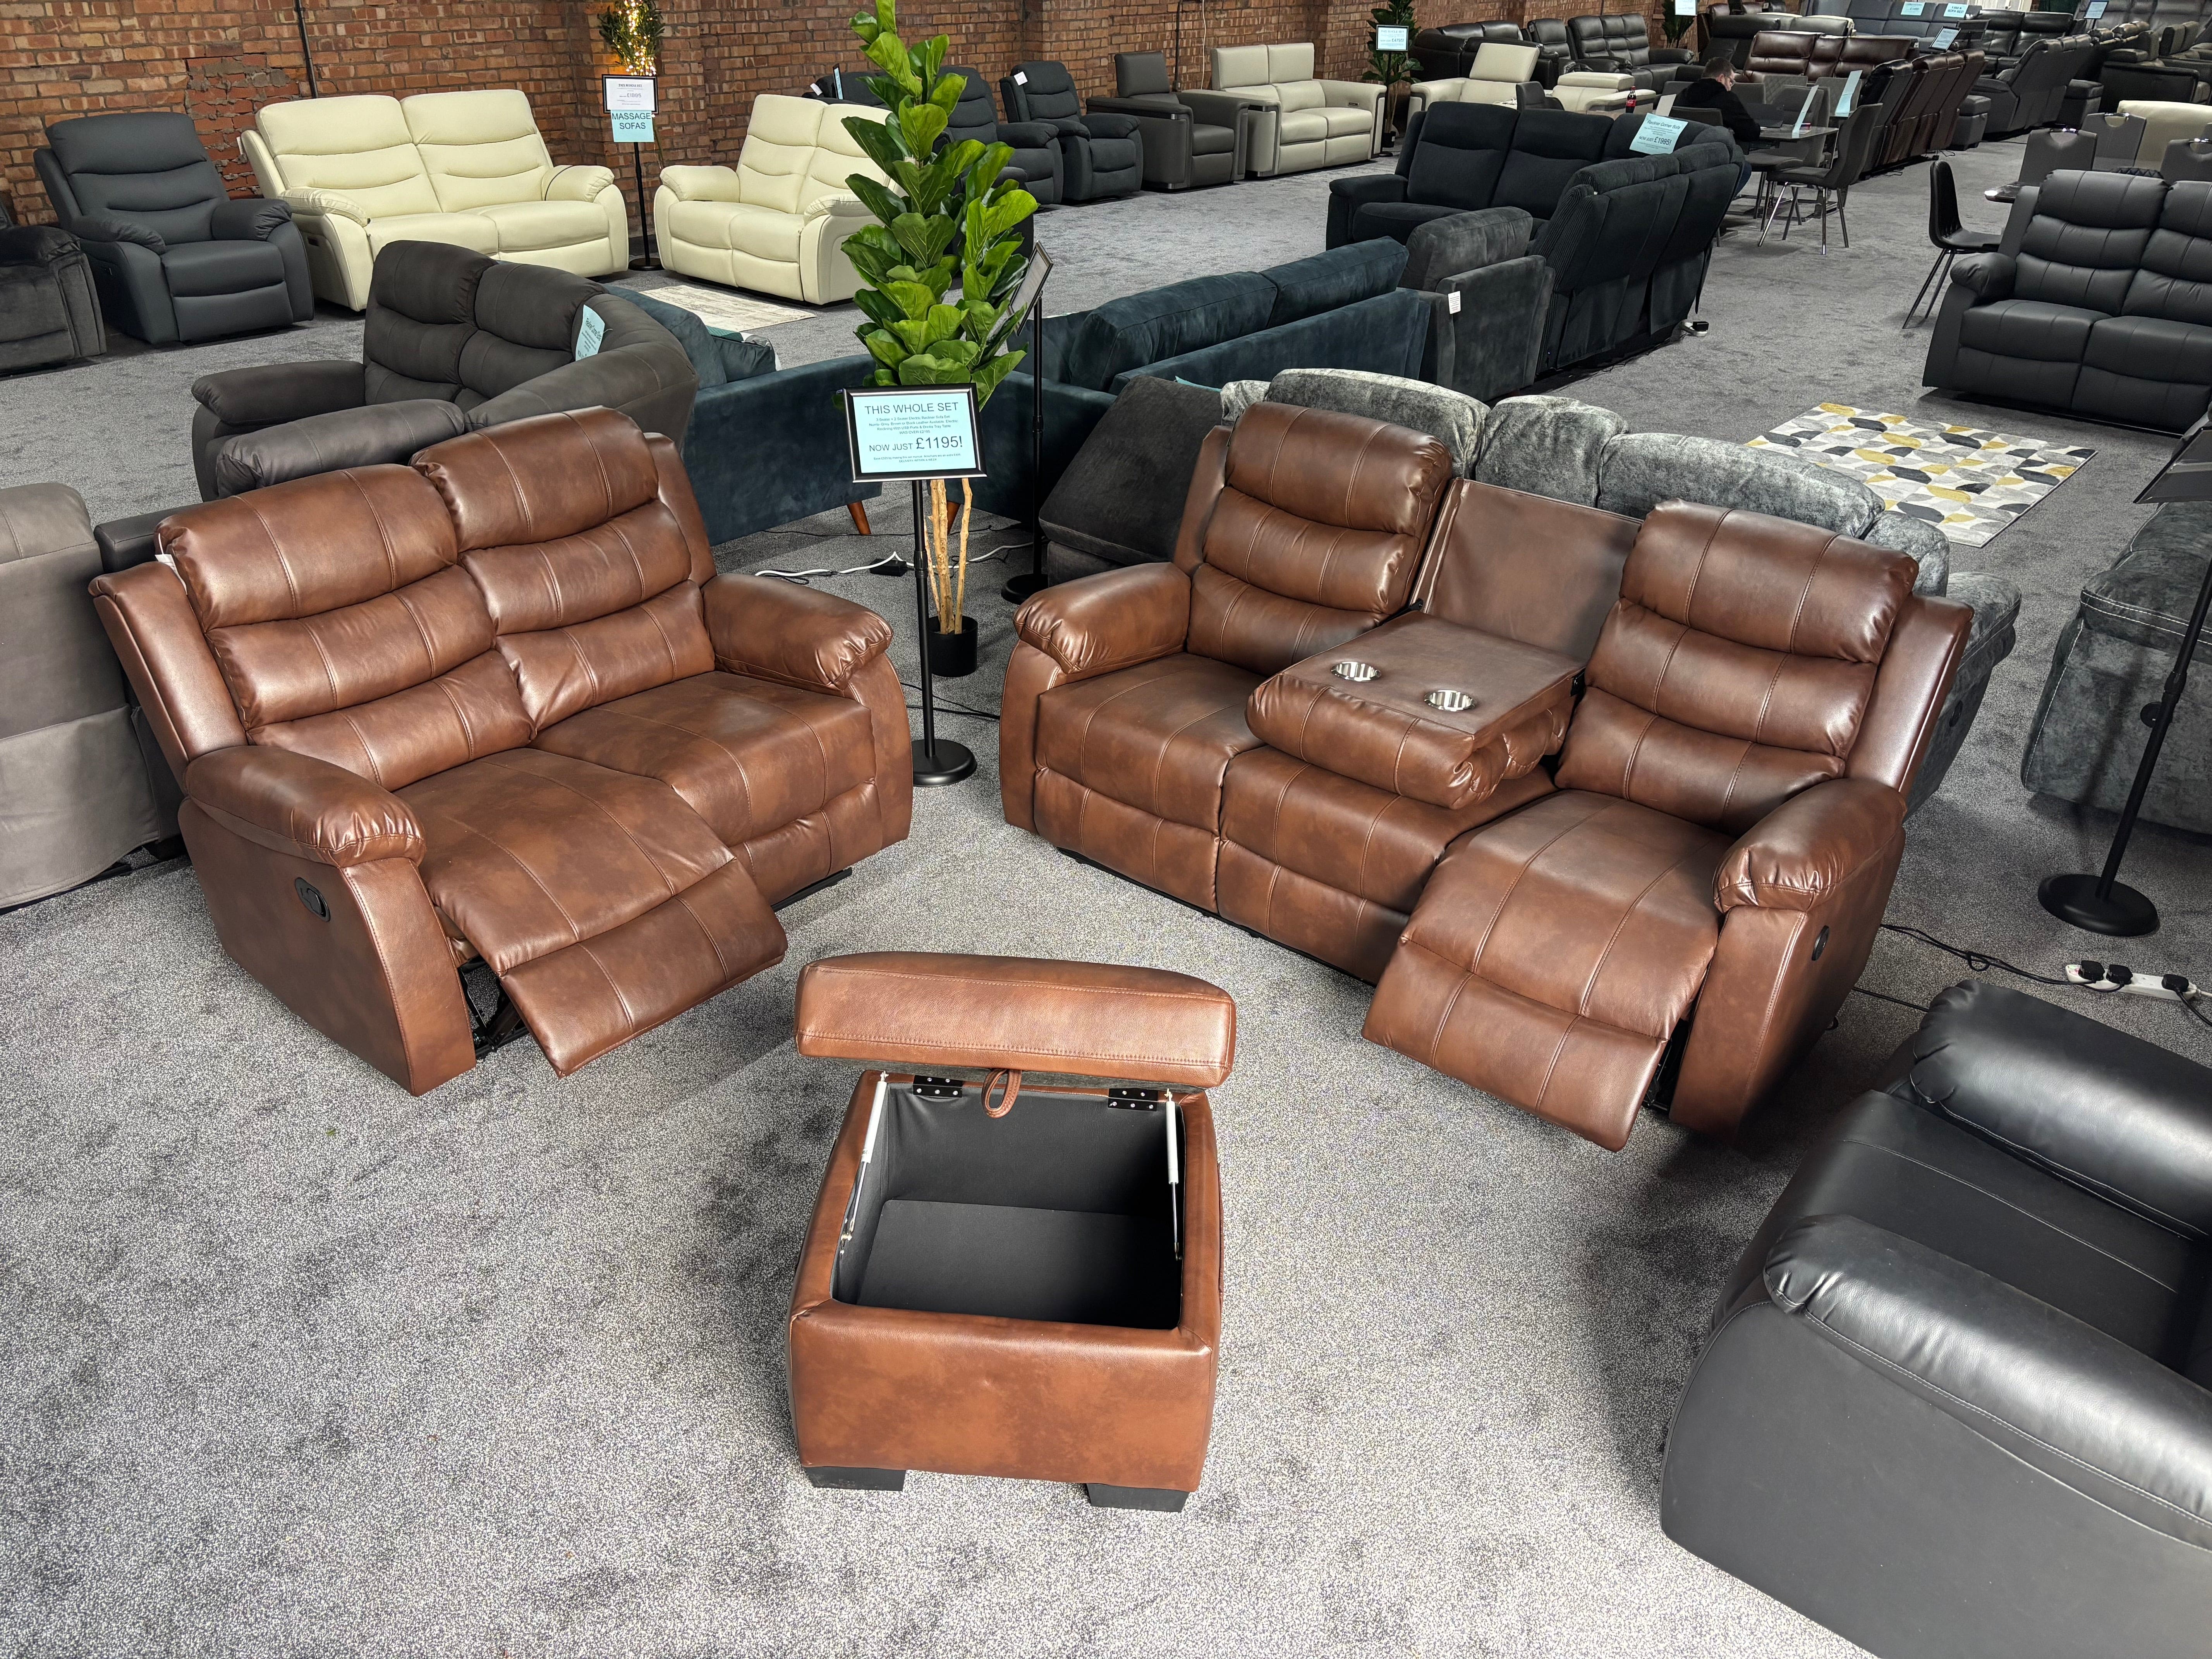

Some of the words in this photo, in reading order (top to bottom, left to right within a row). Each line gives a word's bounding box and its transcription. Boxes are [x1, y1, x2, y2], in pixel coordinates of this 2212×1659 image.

[864, 405, 890, 414] THIS
[893, 403, 934, 413] WHOLE
[938, 402, 958, 411] SET
[916, 436, 962, 449] £1195!
